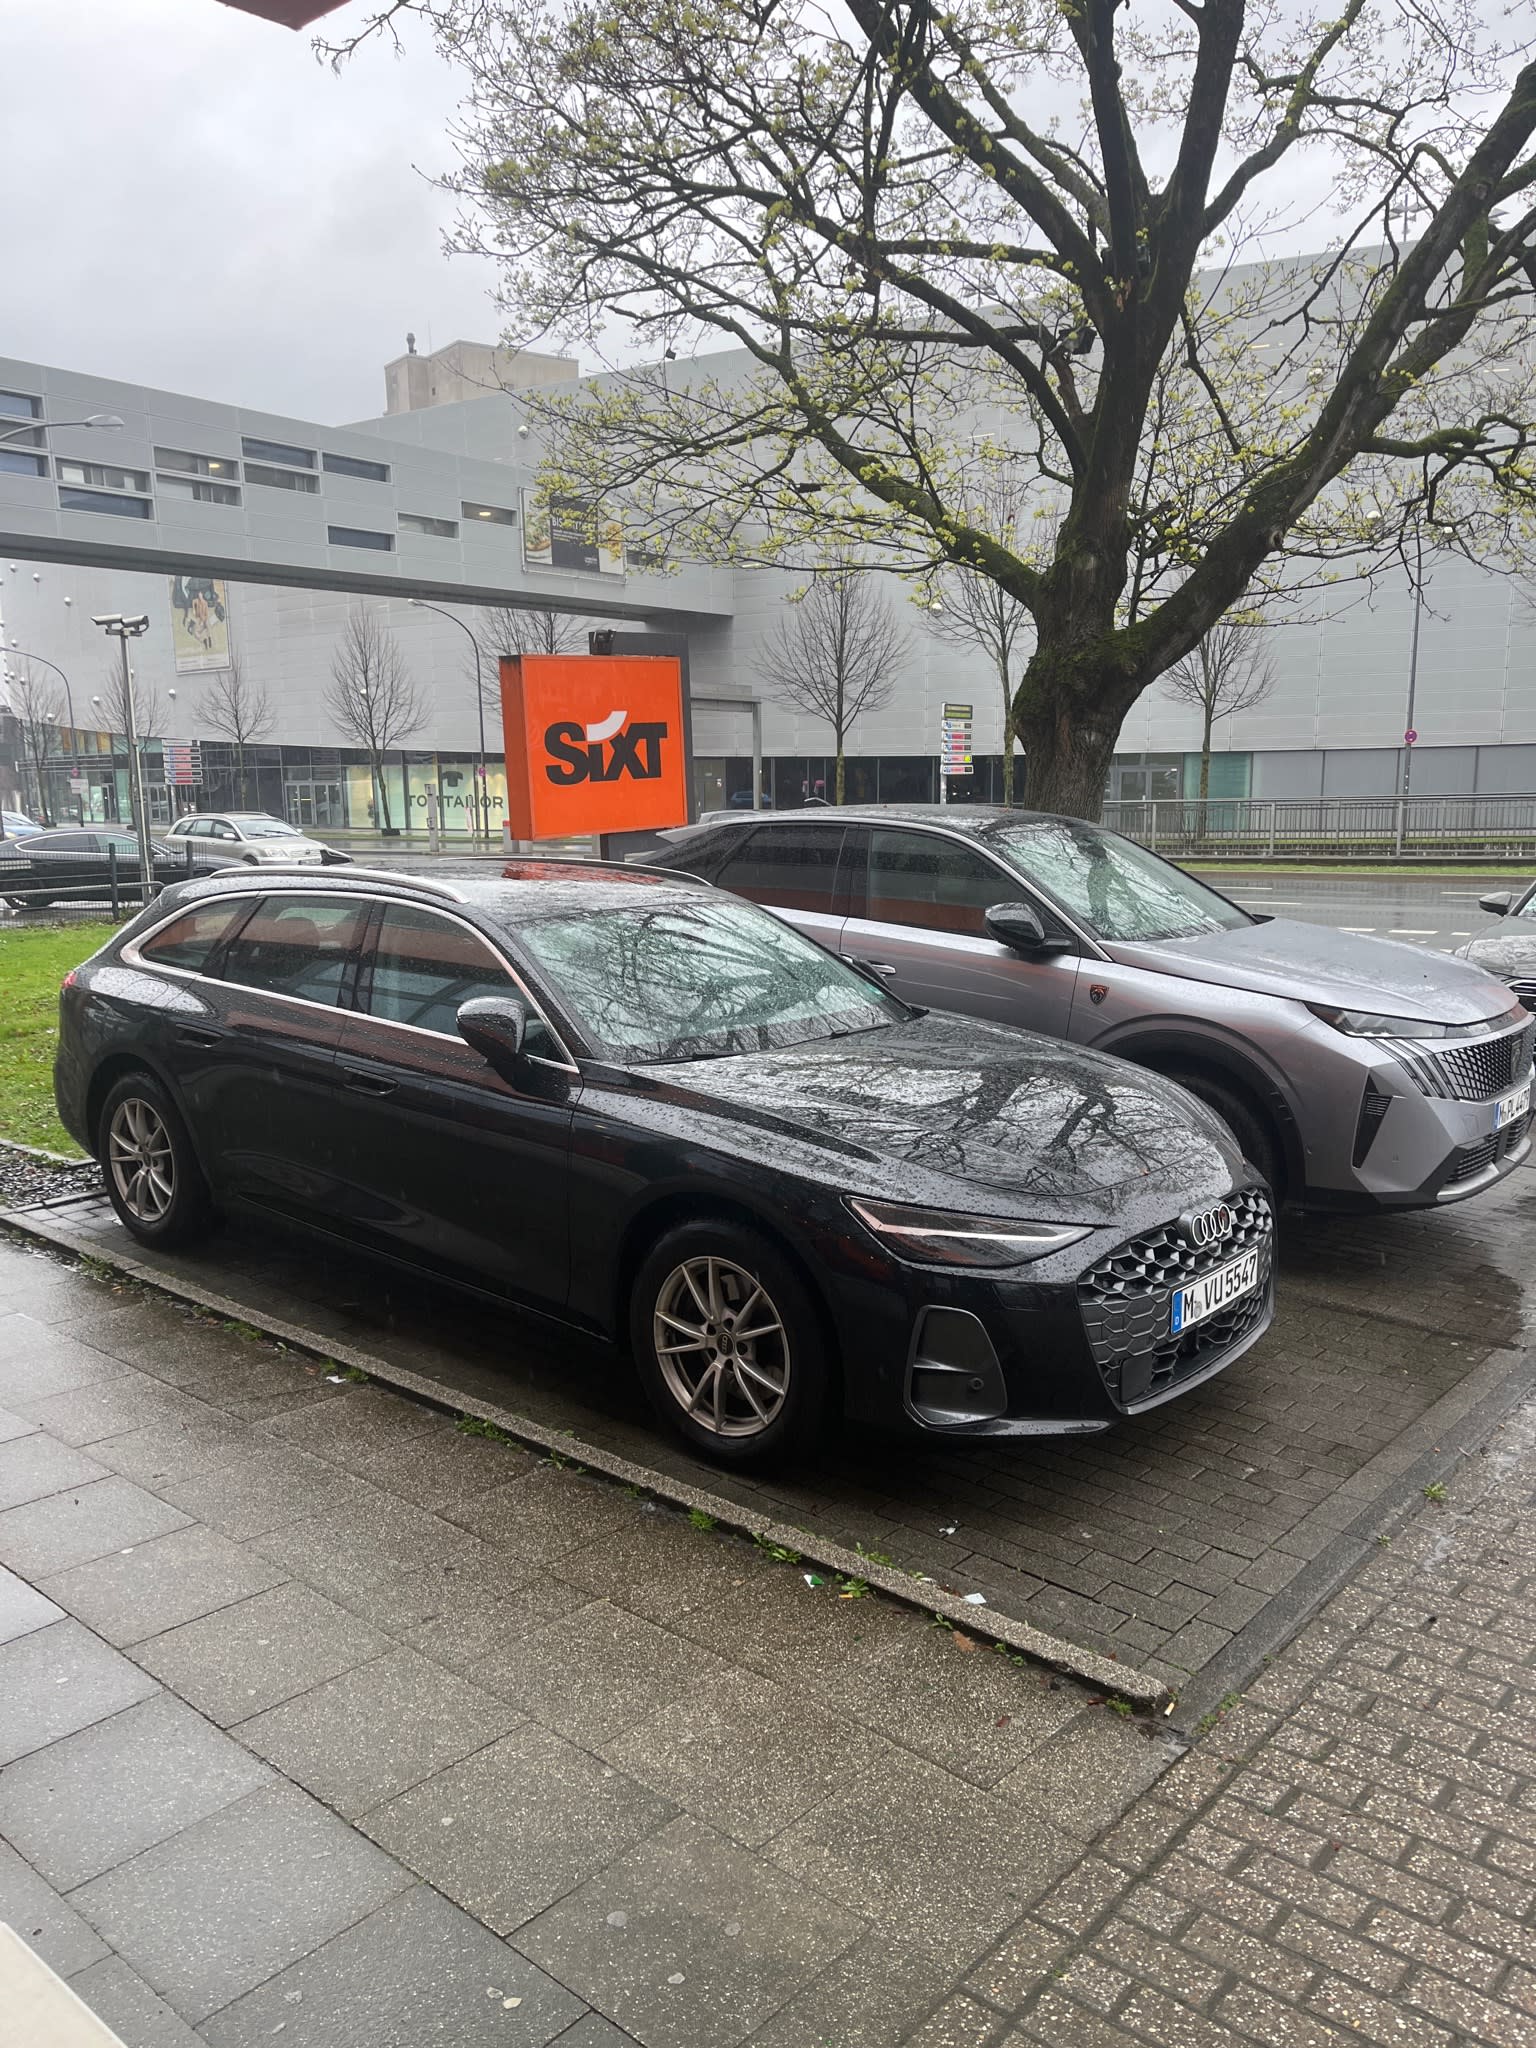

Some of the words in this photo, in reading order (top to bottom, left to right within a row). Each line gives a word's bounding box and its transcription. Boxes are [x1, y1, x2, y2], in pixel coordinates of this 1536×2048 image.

[1184, 1290, 1194, 1322] M
[1204, 1270, 1223, 1310] VU
[1225, 1254, 1257, 1298] 5547
